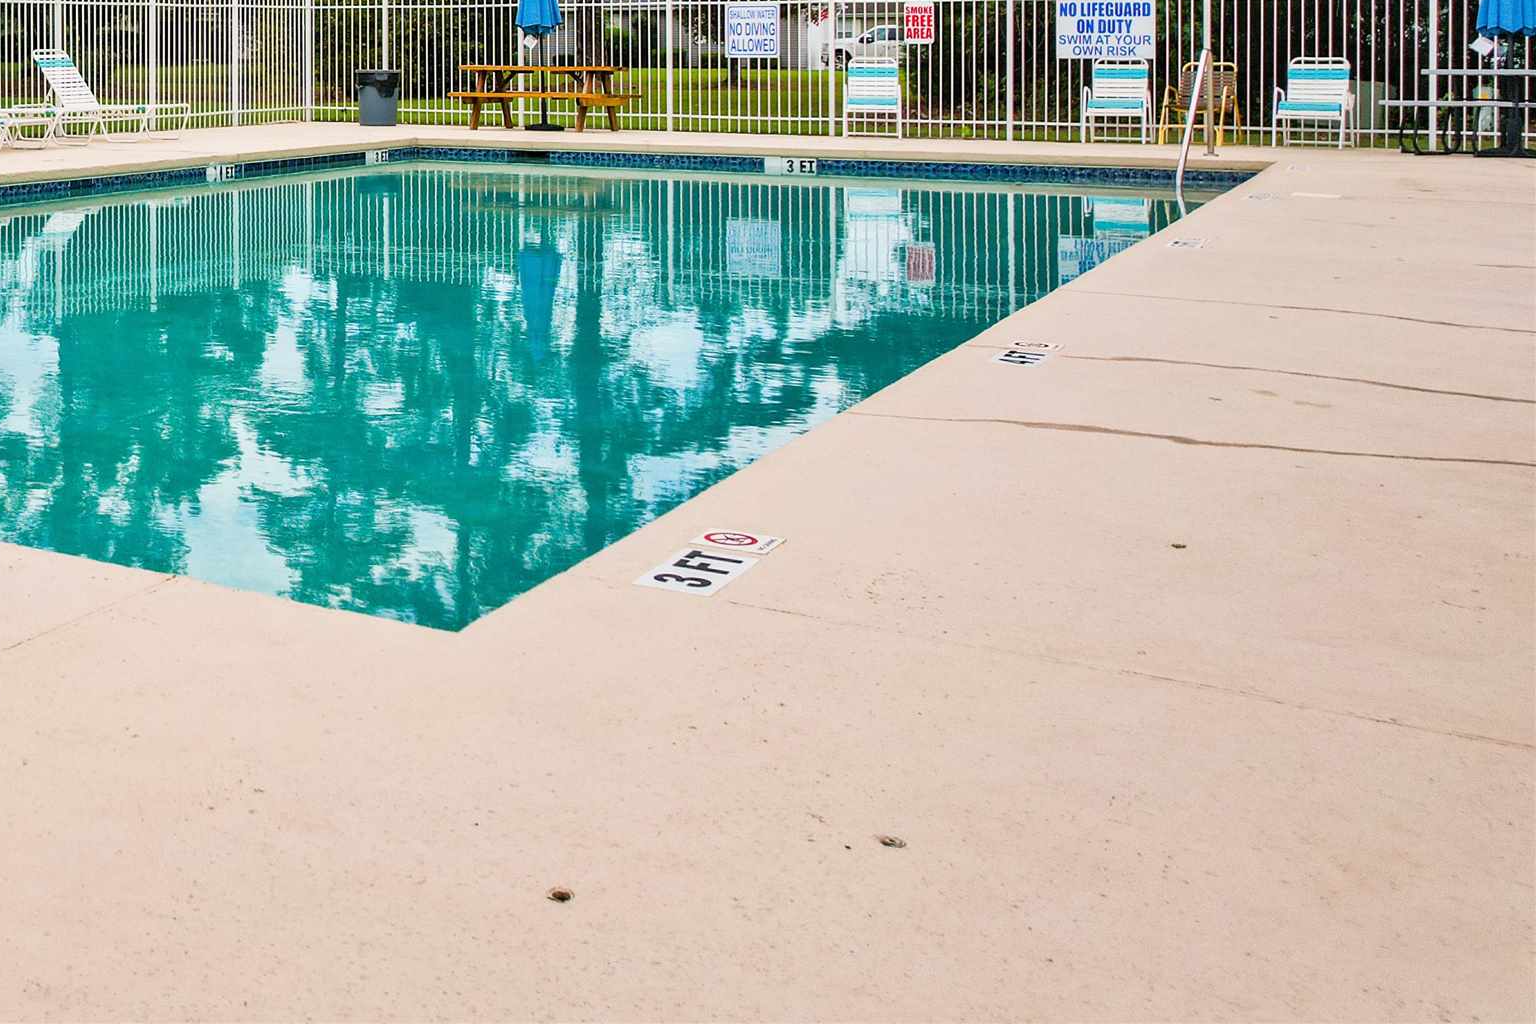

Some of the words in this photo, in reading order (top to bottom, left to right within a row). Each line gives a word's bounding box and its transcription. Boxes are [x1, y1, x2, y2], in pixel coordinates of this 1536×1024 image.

[905, 6, 933, 14] SMOKE
[1060, 2, 1077, 17] NO
[1080, 2, 1151, 17] LIFEGUARD
[905, 14, 933, 27] FREE
[1077, 19, 1094, 33] ON
[1098, 19, 1132, 33] DUTY
[729, 22, 743, 36] NO
[745, 22, 775, 36] DIVING
[906, 27, 933, 39] AREA
[730, 38, 775, 52] ALLOWED
[1058, 35, 1092, 45] SWIM
[1095, 35, 1111, 45] AT
[1114, 35, 1151, 46] YOUR
[1072, 46, 1103, 56] OWN
[1106, 46, 1136, 56] RISK
[786, 160, 794, 174] 3
[672, 550, 744, 575] FT
[654, 573, 712, 588] 3
